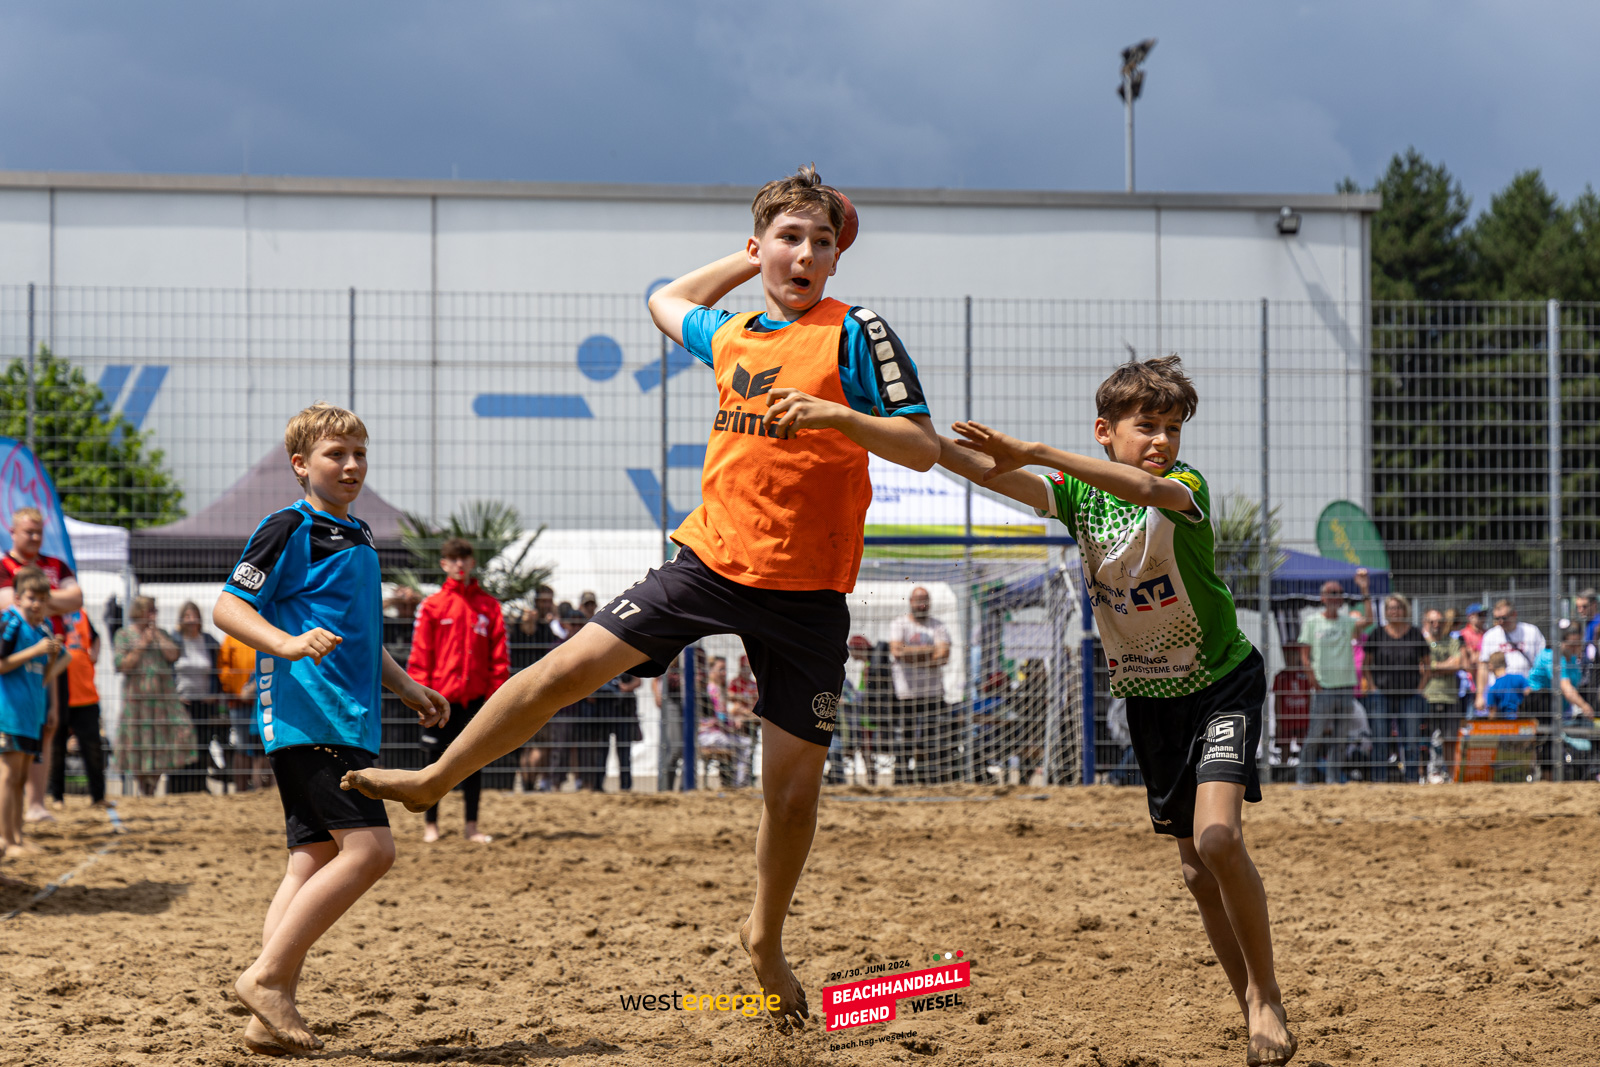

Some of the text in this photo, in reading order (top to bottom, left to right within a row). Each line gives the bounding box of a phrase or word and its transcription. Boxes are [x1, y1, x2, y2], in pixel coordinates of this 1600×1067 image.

[611, 599, 642, 620] 17
[1114, 603, 1128, 615] eG
[1208, 745, 1233, 753] Johann
